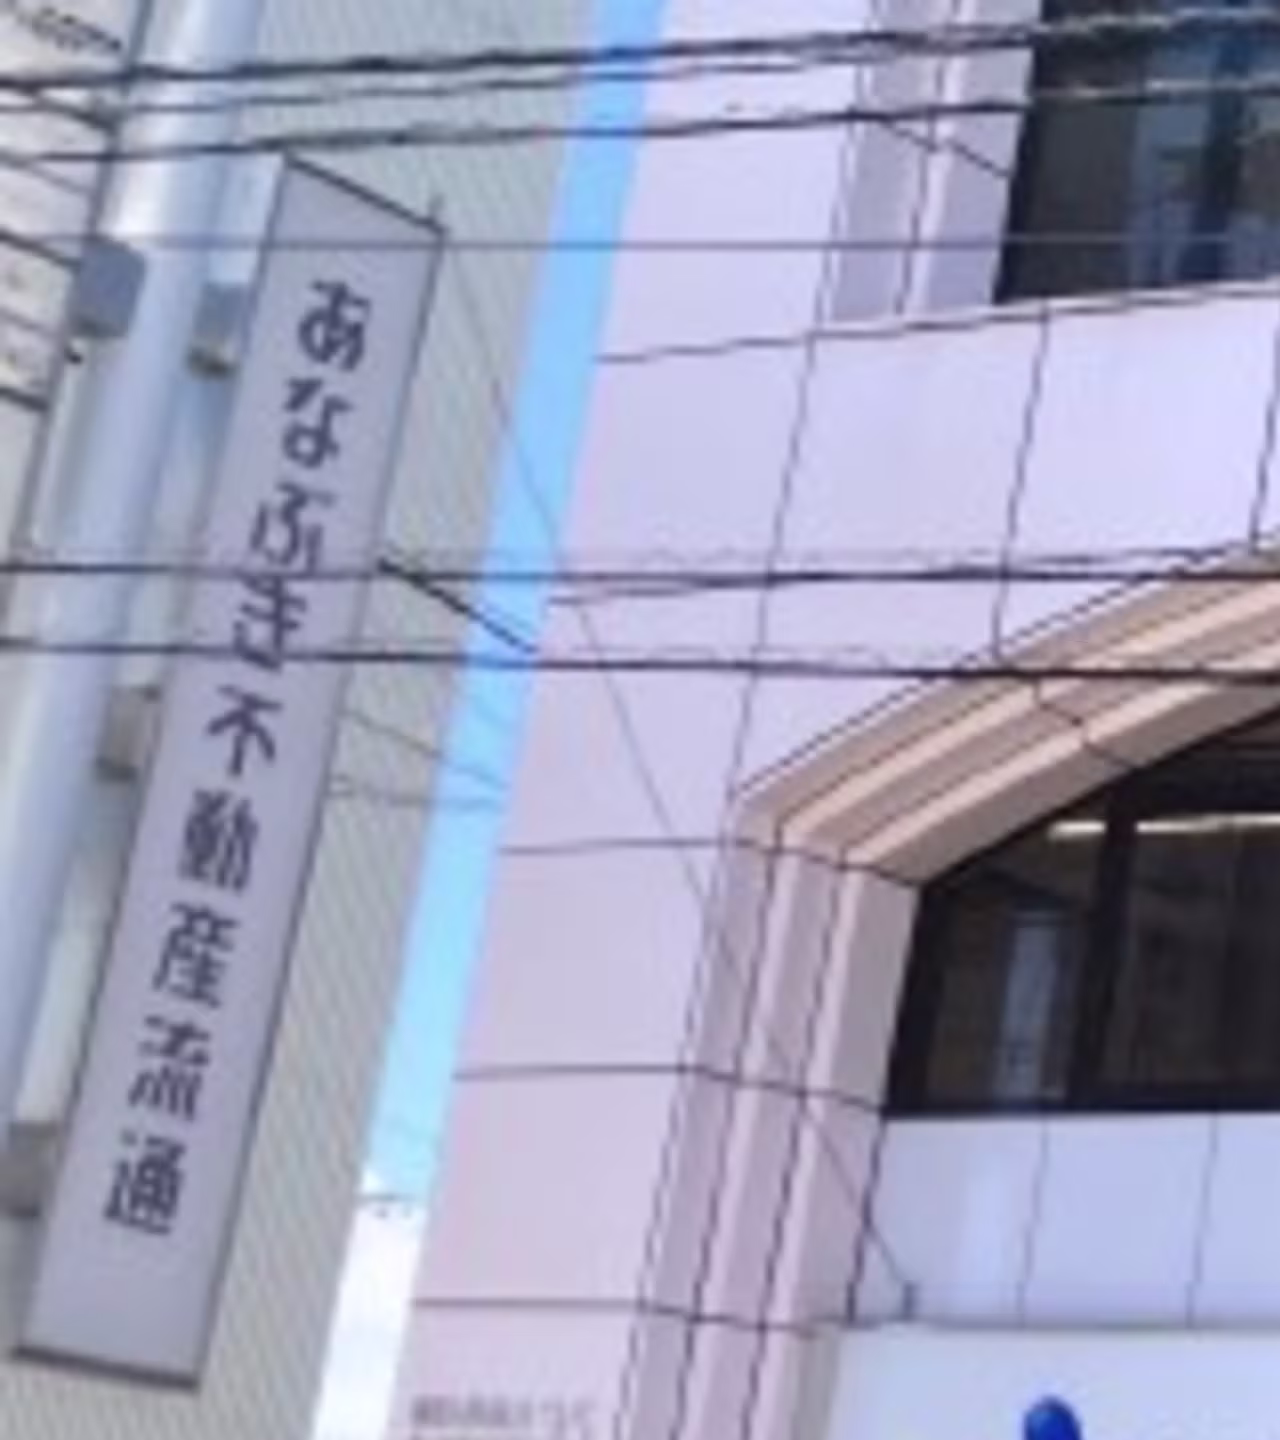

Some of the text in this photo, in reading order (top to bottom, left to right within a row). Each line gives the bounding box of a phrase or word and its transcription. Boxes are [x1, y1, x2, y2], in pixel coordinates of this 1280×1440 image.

[104, 280, 372, 1236] あなぶき不動産流通
